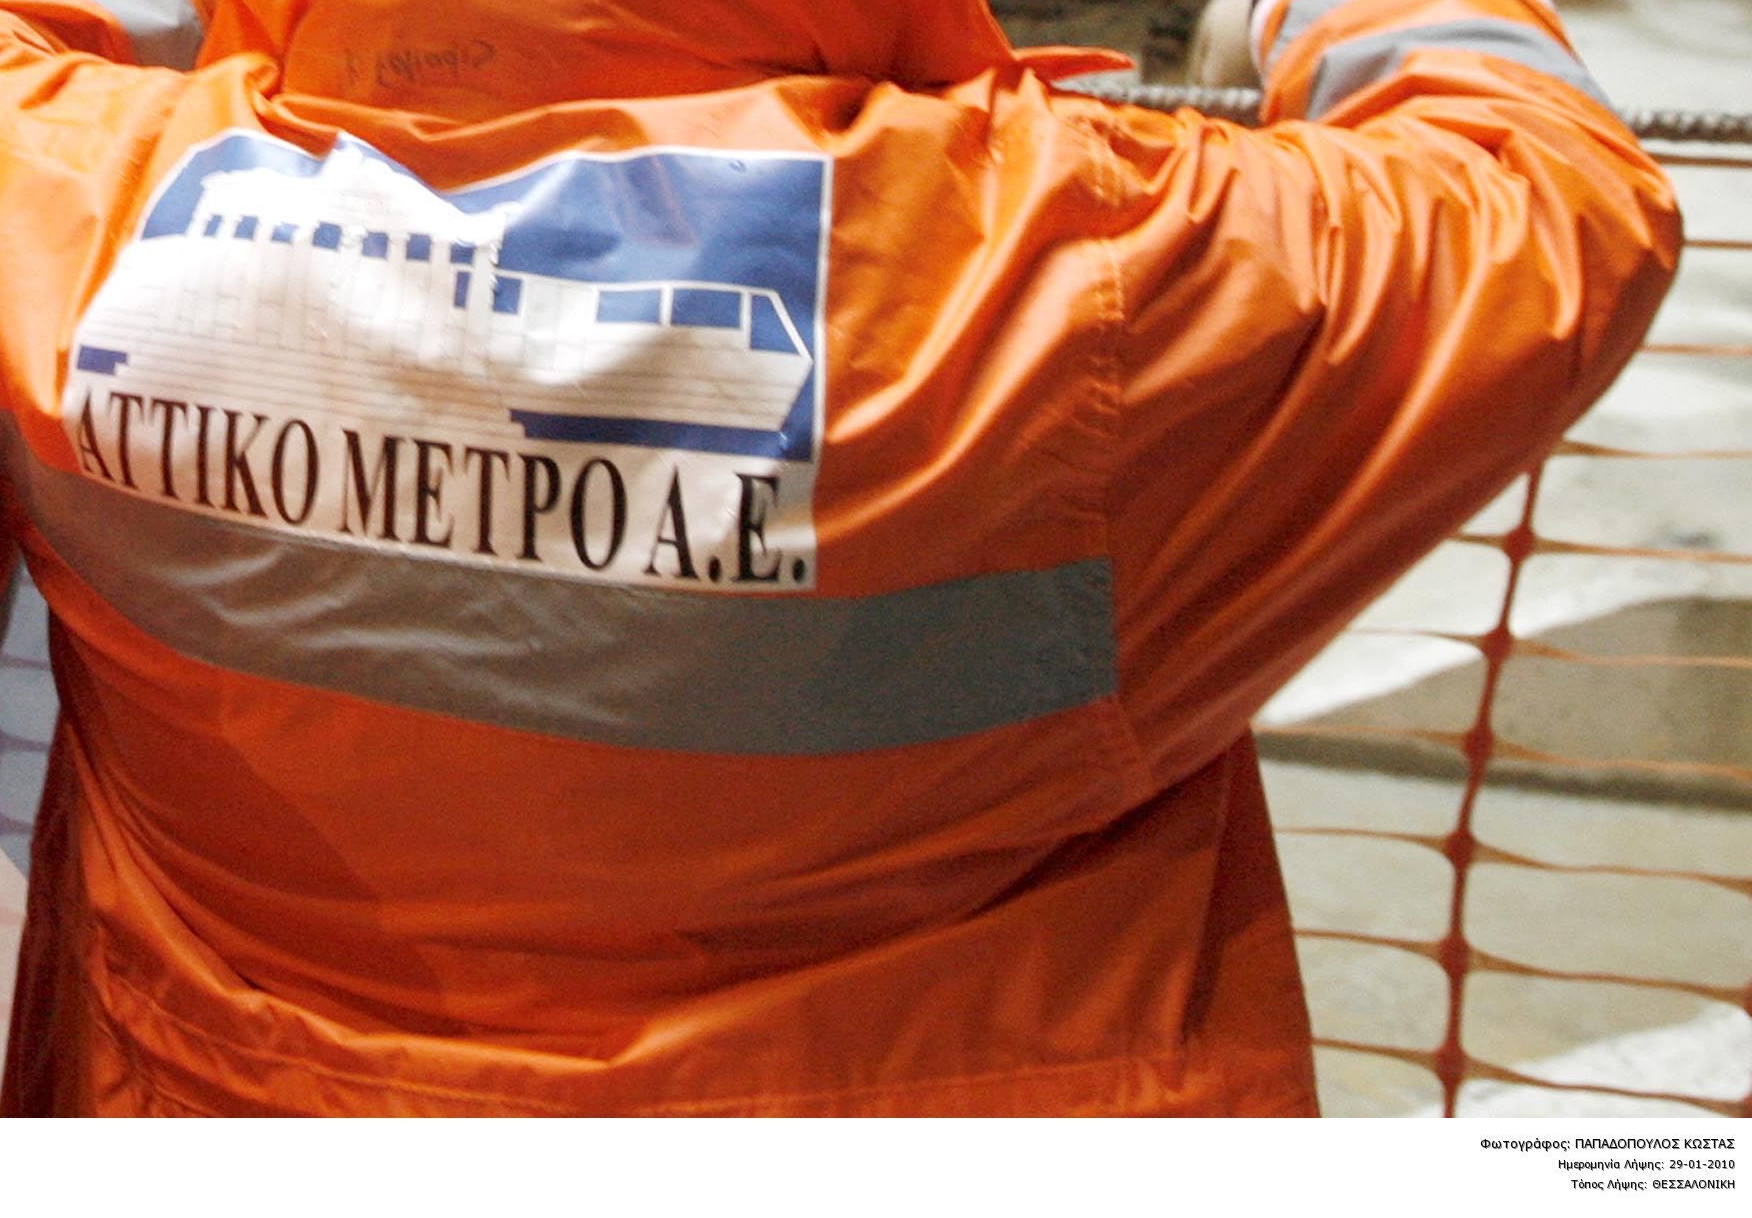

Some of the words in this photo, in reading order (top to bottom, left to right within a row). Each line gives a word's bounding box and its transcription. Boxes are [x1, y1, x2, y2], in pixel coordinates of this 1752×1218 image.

[78, 388, 319, 525] ΑΤΤΙΚΟ
[338, 428, 627, 572] ΜΕΤΡΟ
[643, 464, 807, 583] Α.Ε.
